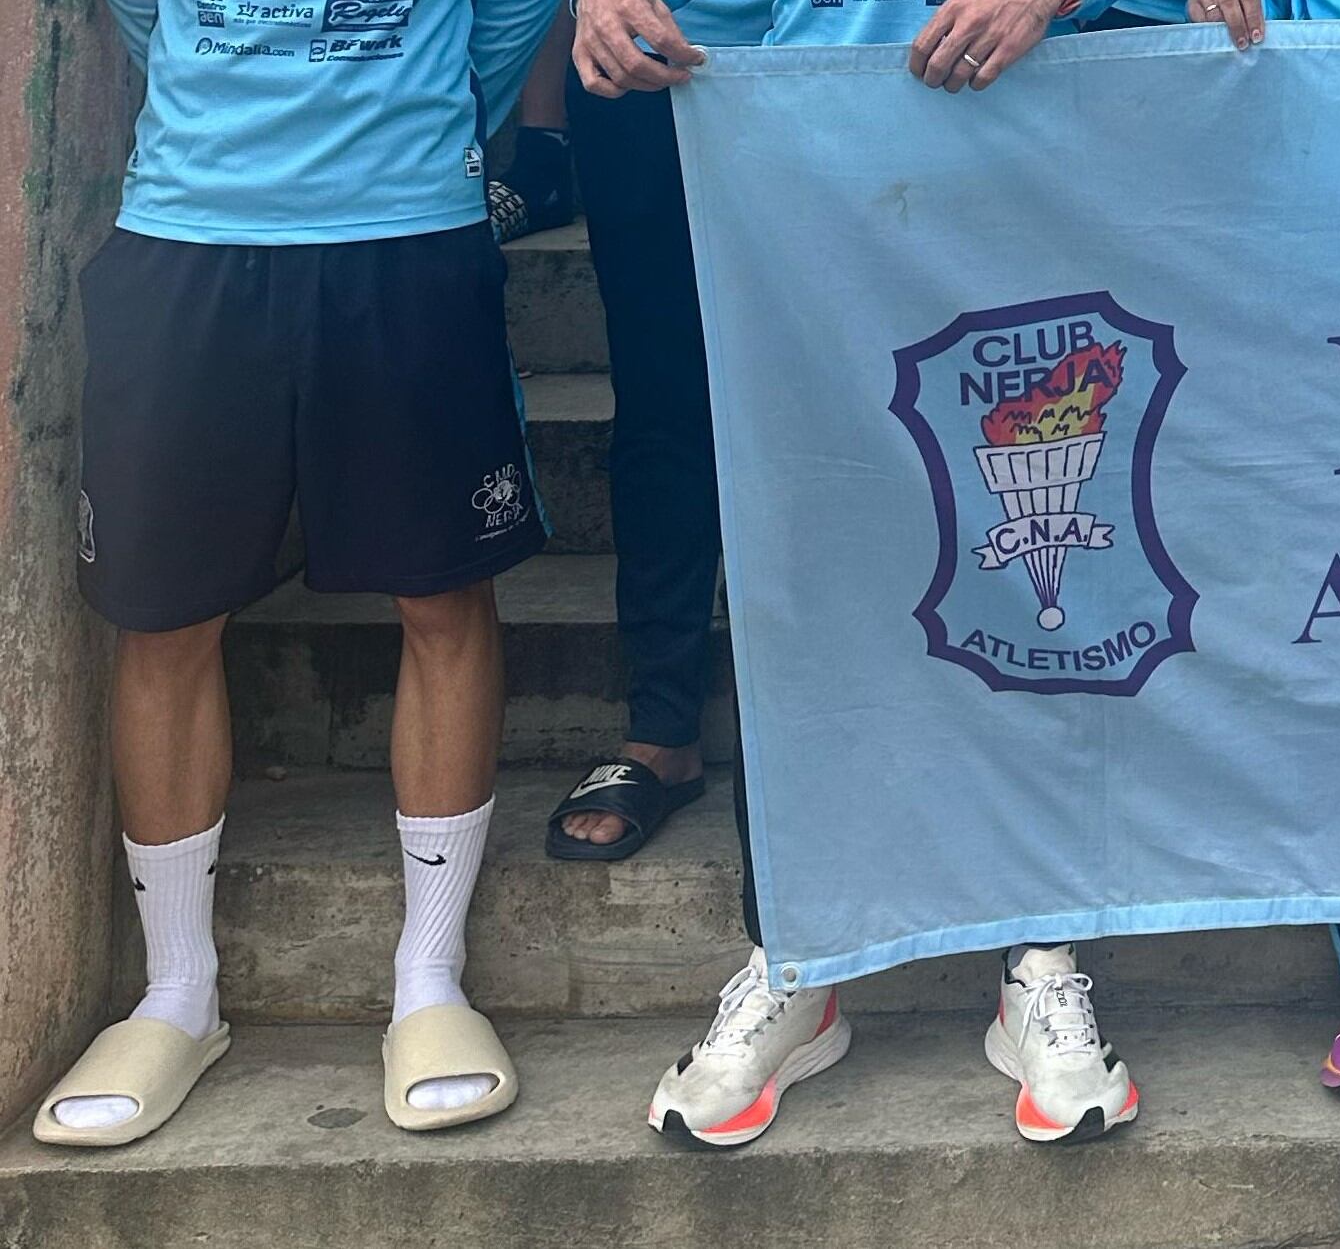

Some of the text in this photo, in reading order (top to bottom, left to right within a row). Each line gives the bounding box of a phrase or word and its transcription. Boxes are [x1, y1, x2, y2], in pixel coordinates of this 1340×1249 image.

[199, 12, 224, 25] aen
[260, 3, 314, 20] activa
[212, 41, 295, 58] Mindalia.com
[973, 319, 1097, 368] CLUB
[959, 355, 1114, 405] NERJA
[995, 518, 1089, 555] C.N.A.
[961, 620, 1158, 673] ATLETISMO
[583, 764, 633, 785] NIKE
